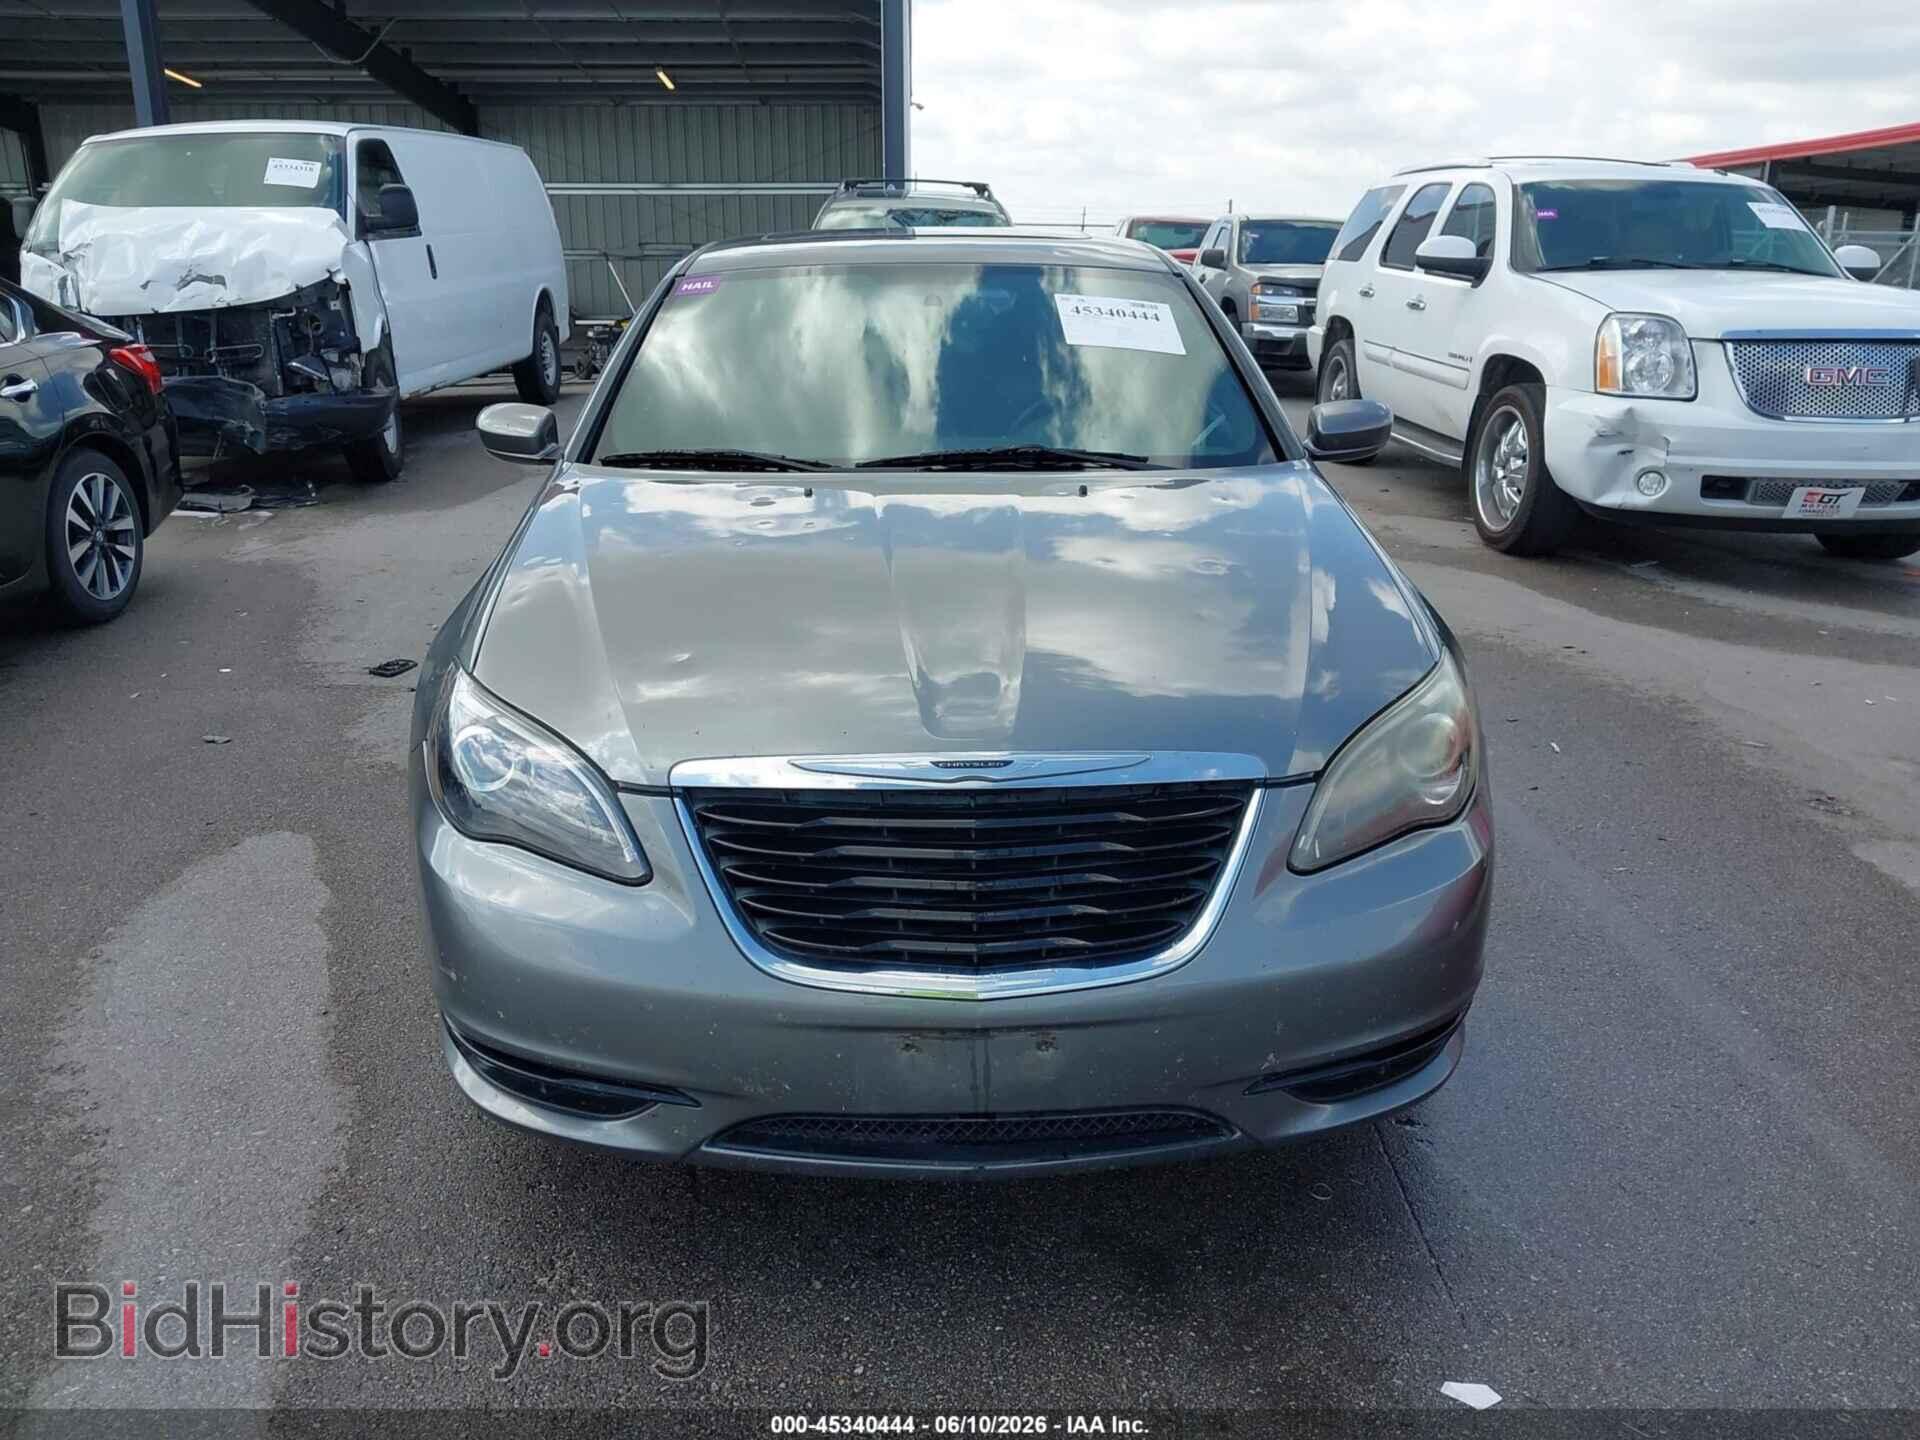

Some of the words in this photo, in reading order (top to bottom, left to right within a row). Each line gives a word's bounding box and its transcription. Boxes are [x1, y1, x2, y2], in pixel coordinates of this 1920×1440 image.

[682, 281, 713, 290] HAIL
[1071, 305, 1161, 322] 45340444
[1807, 366, 1889, 386] GMC
[938, 761, 1004, 769] CHRYSLER
